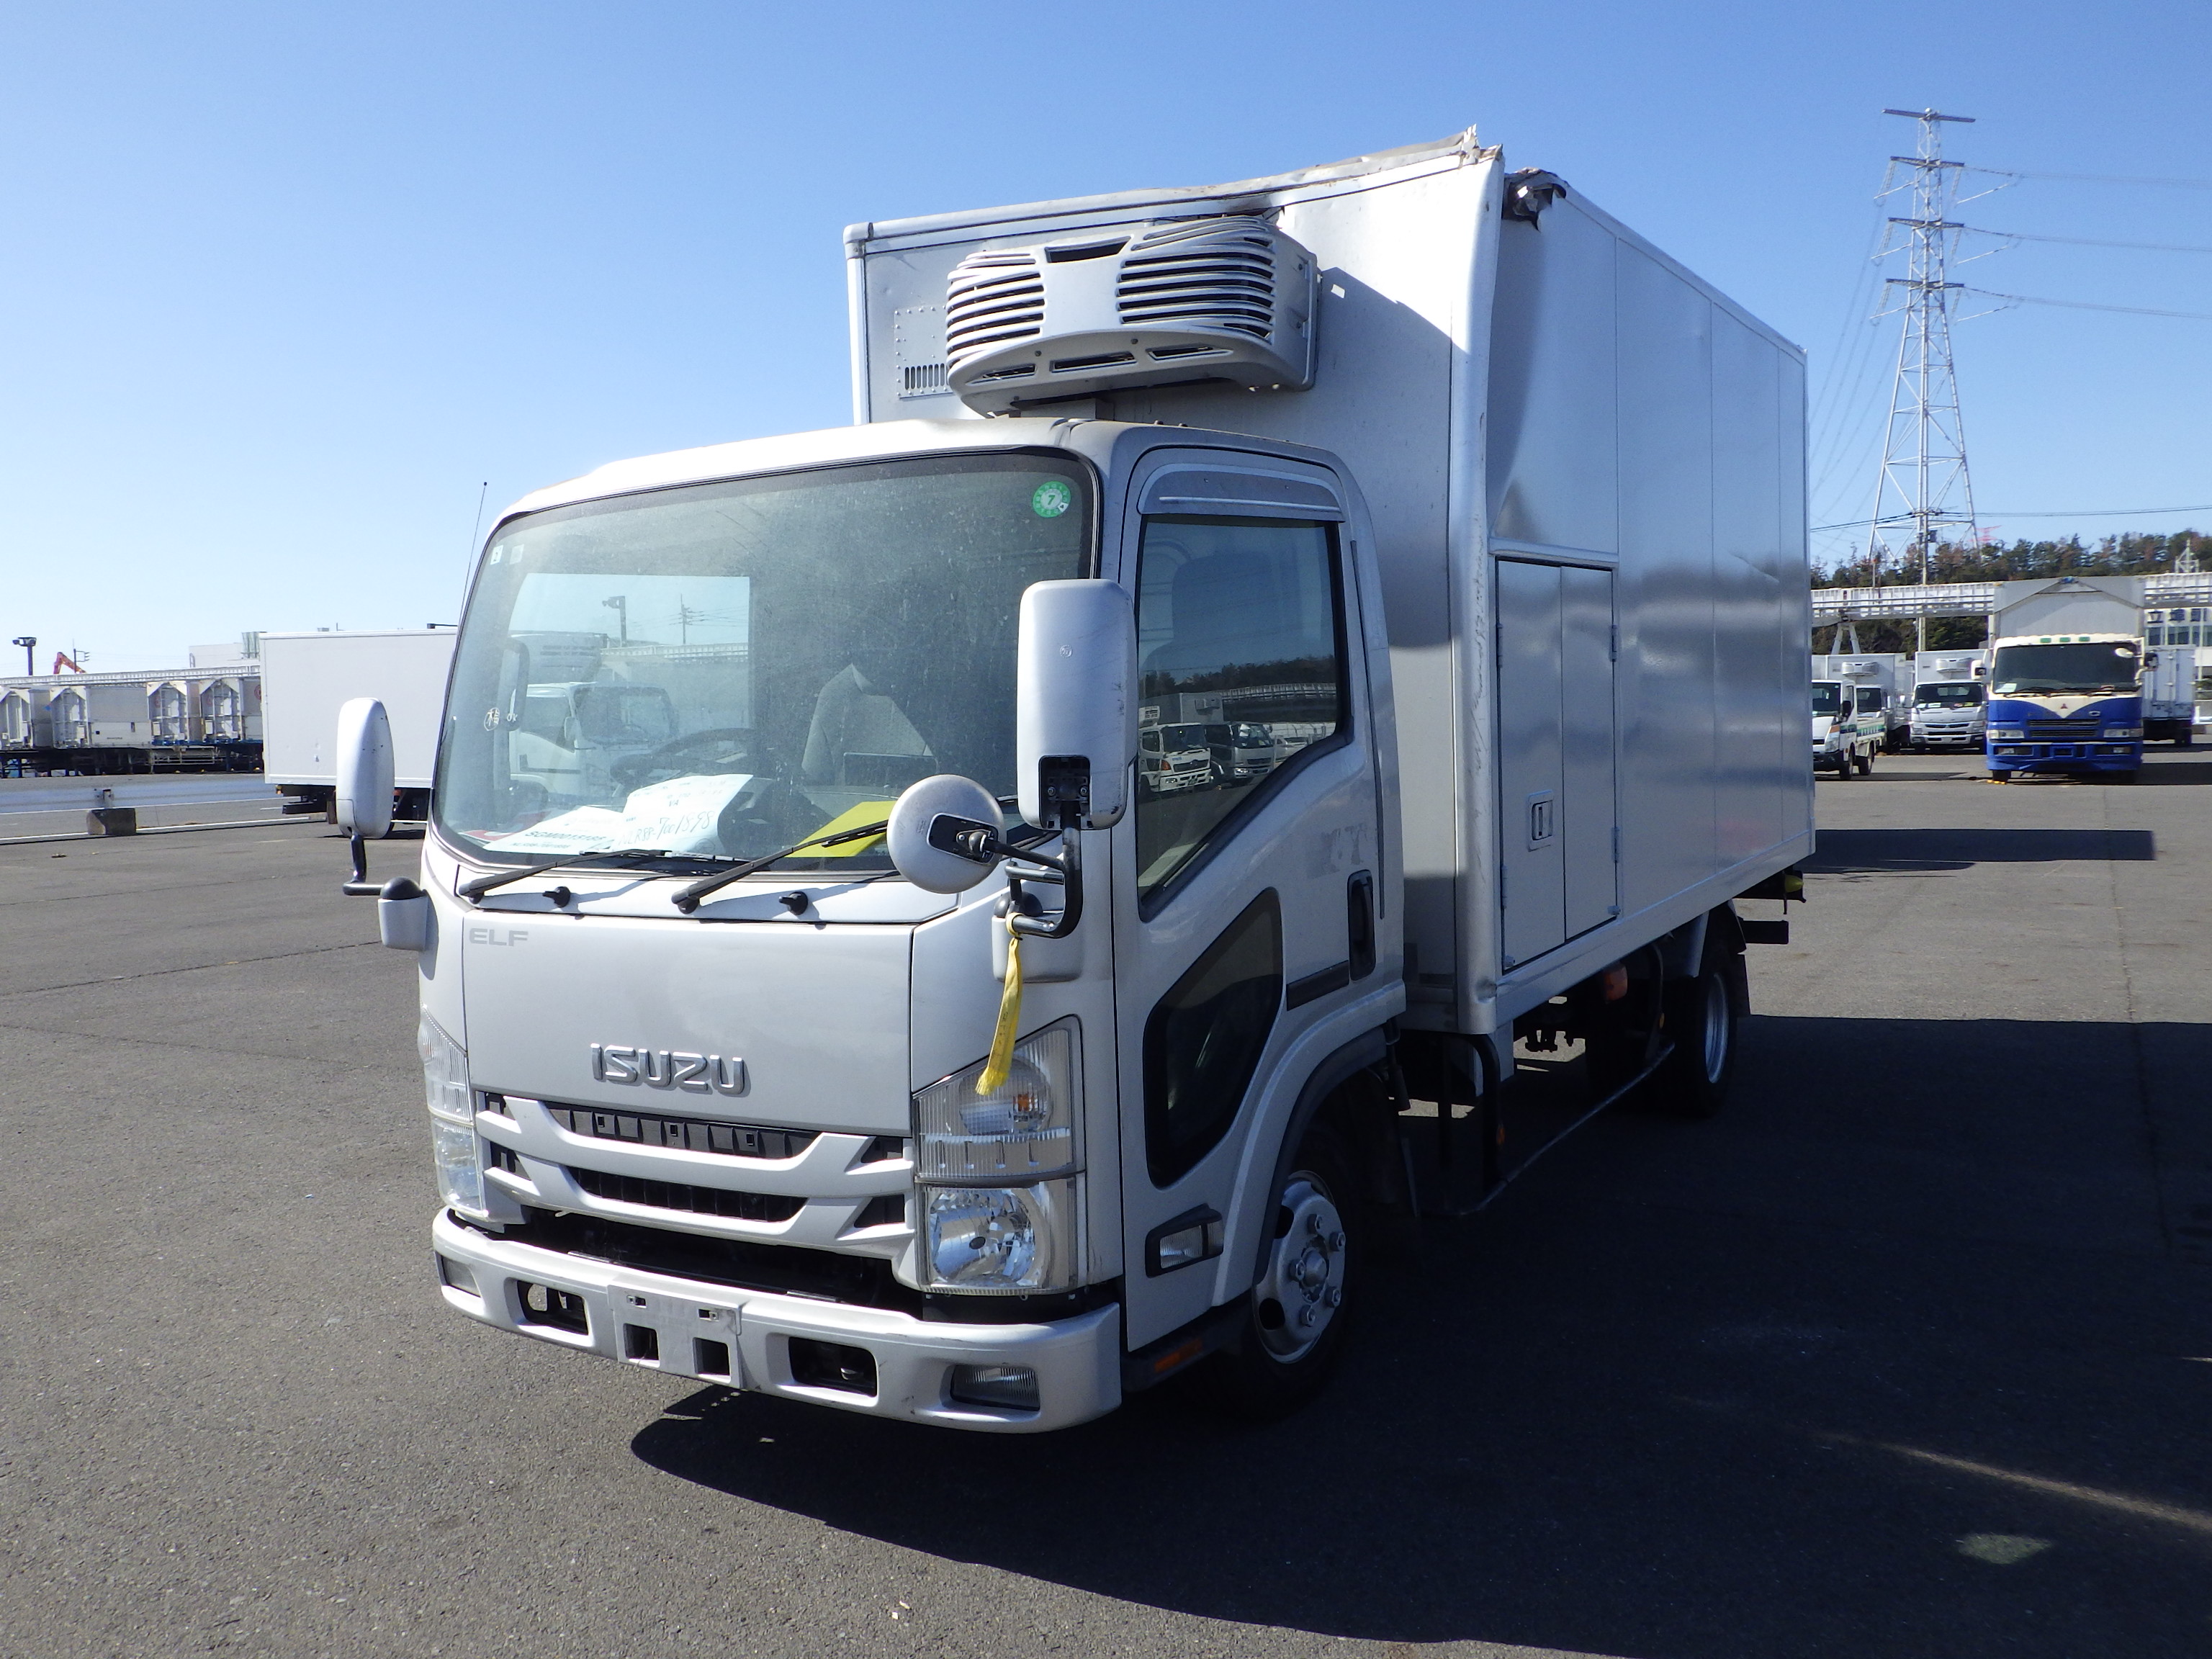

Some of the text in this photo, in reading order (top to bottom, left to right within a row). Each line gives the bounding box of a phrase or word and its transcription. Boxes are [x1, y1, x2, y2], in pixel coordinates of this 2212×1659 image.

[1048, 495, 1056, 505] 7
[469, 928, 529, 946] ELF
[590, 1043, 745, 1094] ISUZU
